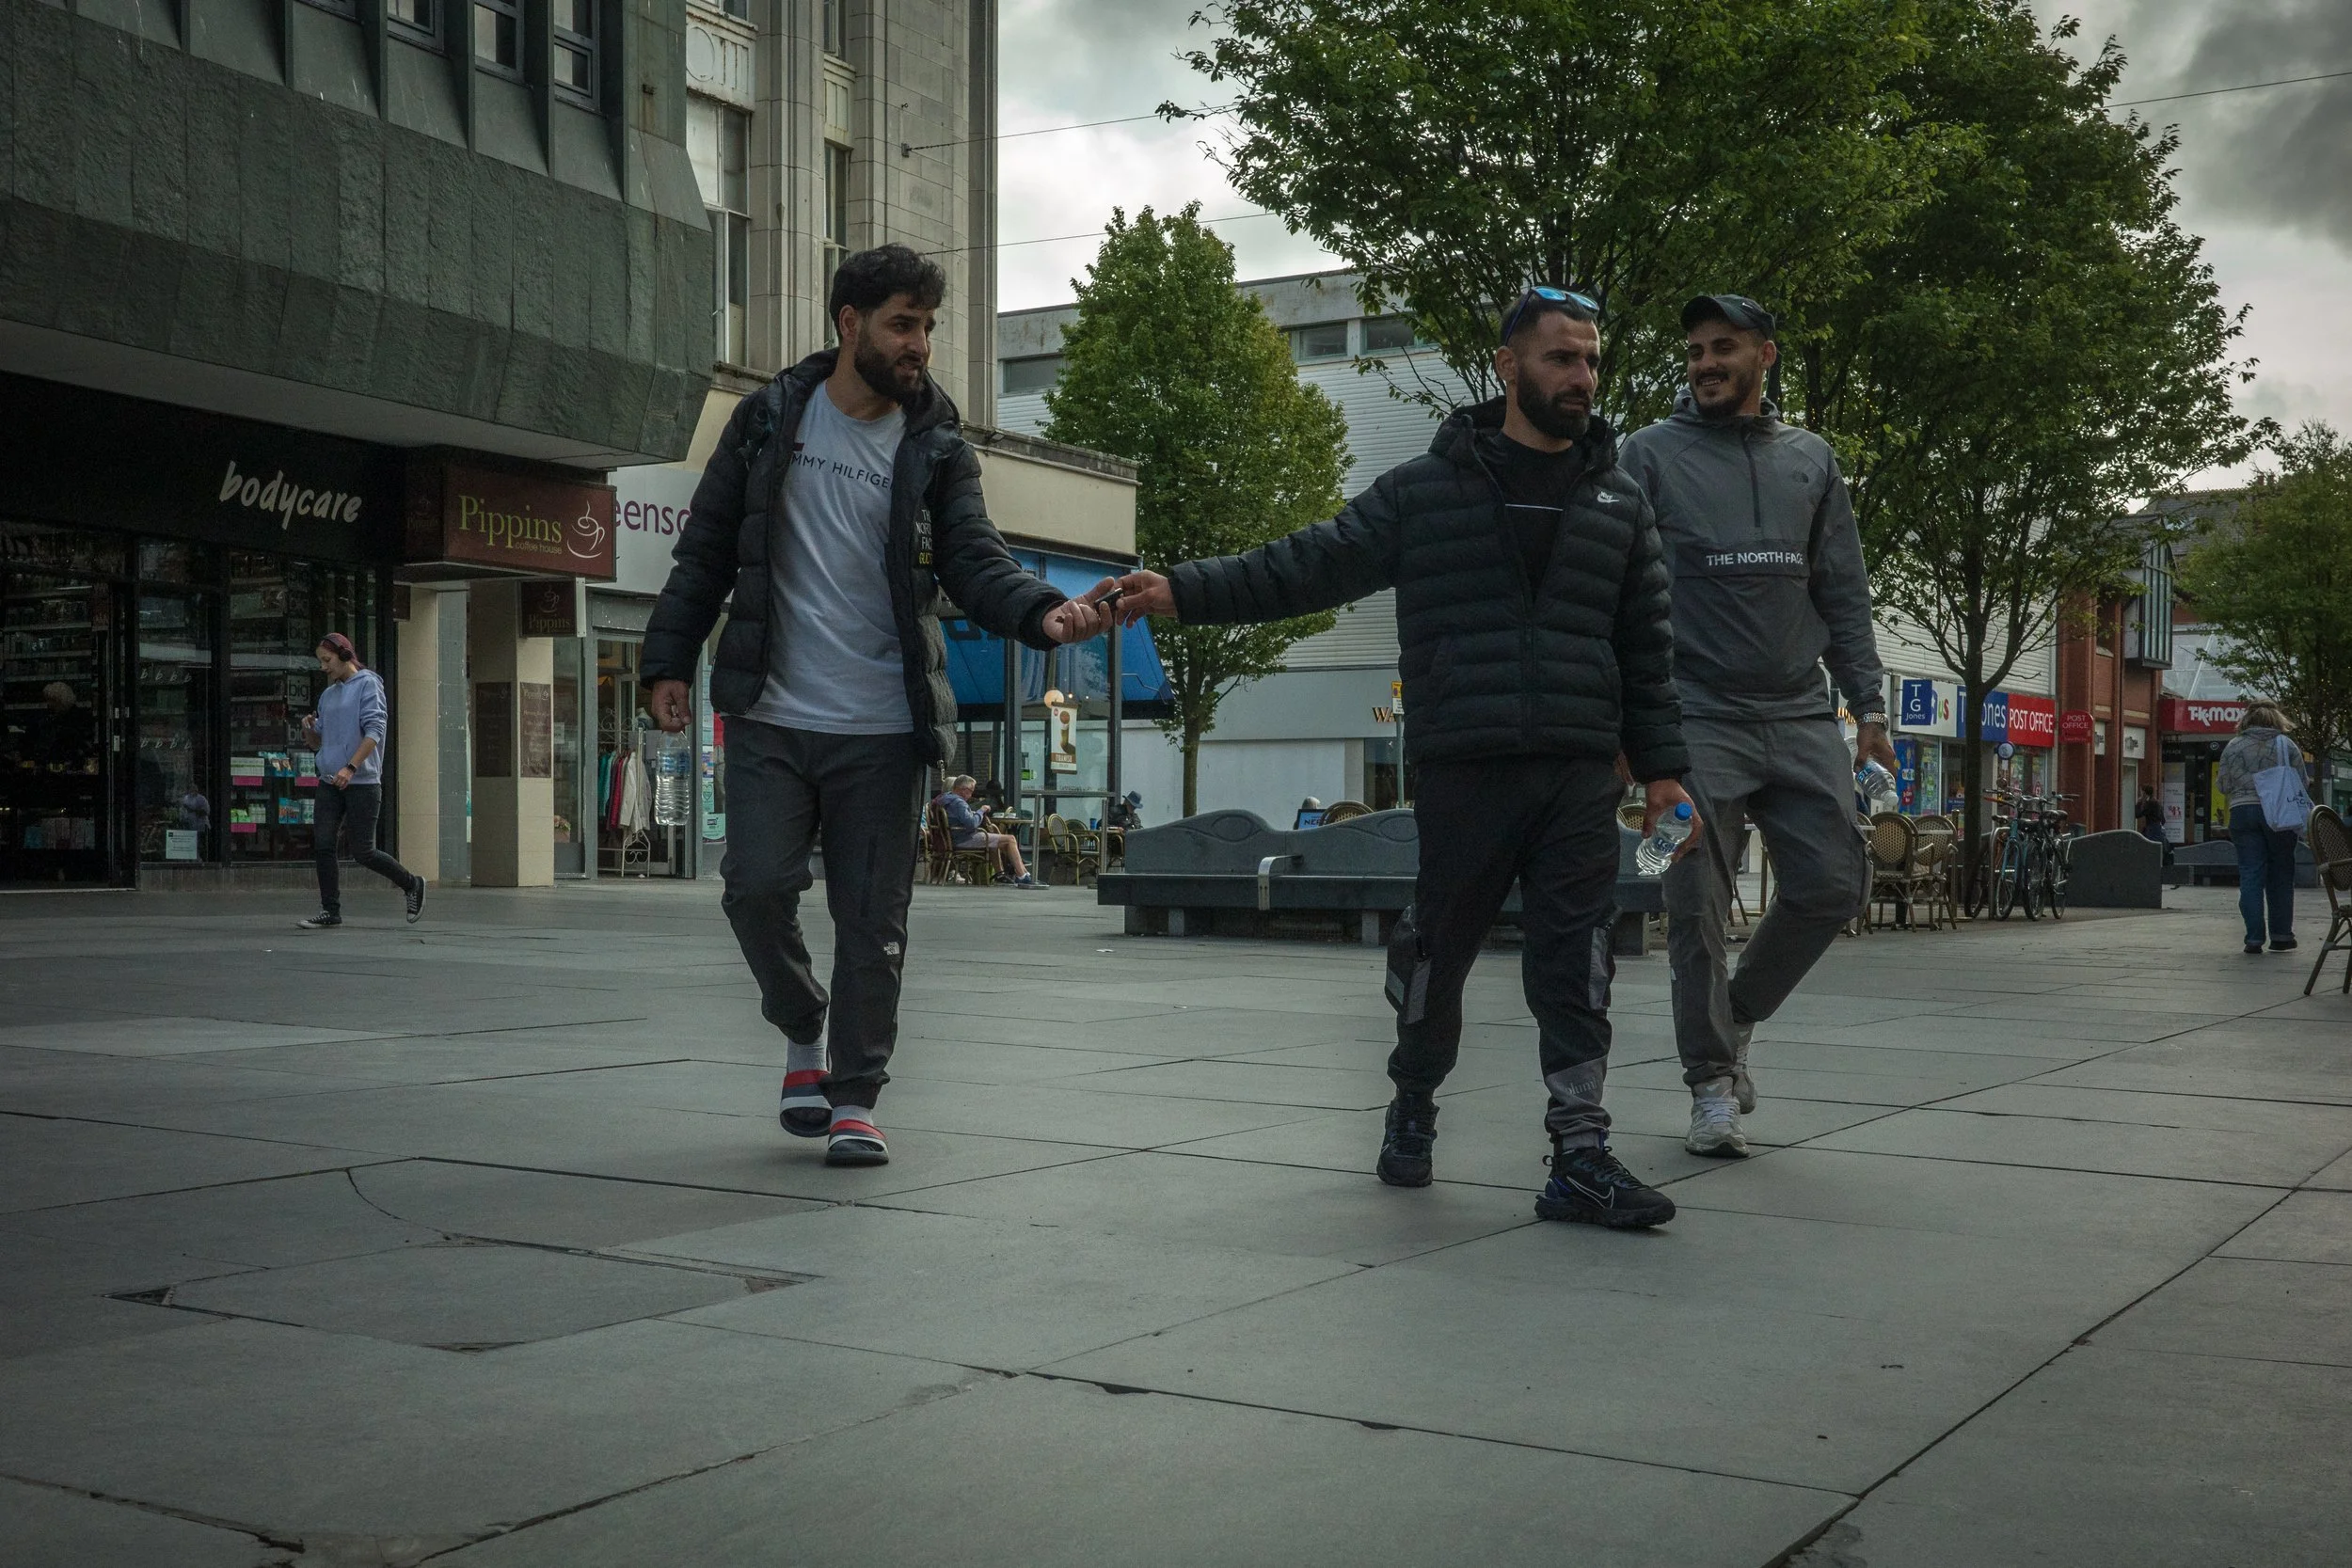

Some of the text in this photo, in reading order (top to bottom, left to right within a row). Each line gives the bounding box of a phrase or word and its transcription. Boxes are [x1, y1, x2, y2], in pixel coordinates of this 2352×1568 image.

[219, 460, 362, 531] bodycare
[458, 495, 563, 548] Pippins
[516, 541, 562, 555] coffee house
[1706, 554, 1734, 566] THE
[1737, 552, 1784, 564] NORTH
[290, 679, 310, 702] big
[1911, 684, 1921, 697] T
[1910, 698, 1921, 712] G
[1905, 712, 1926, 721] Jones
[2009, 708, 2054, 734] POST OFFICE
